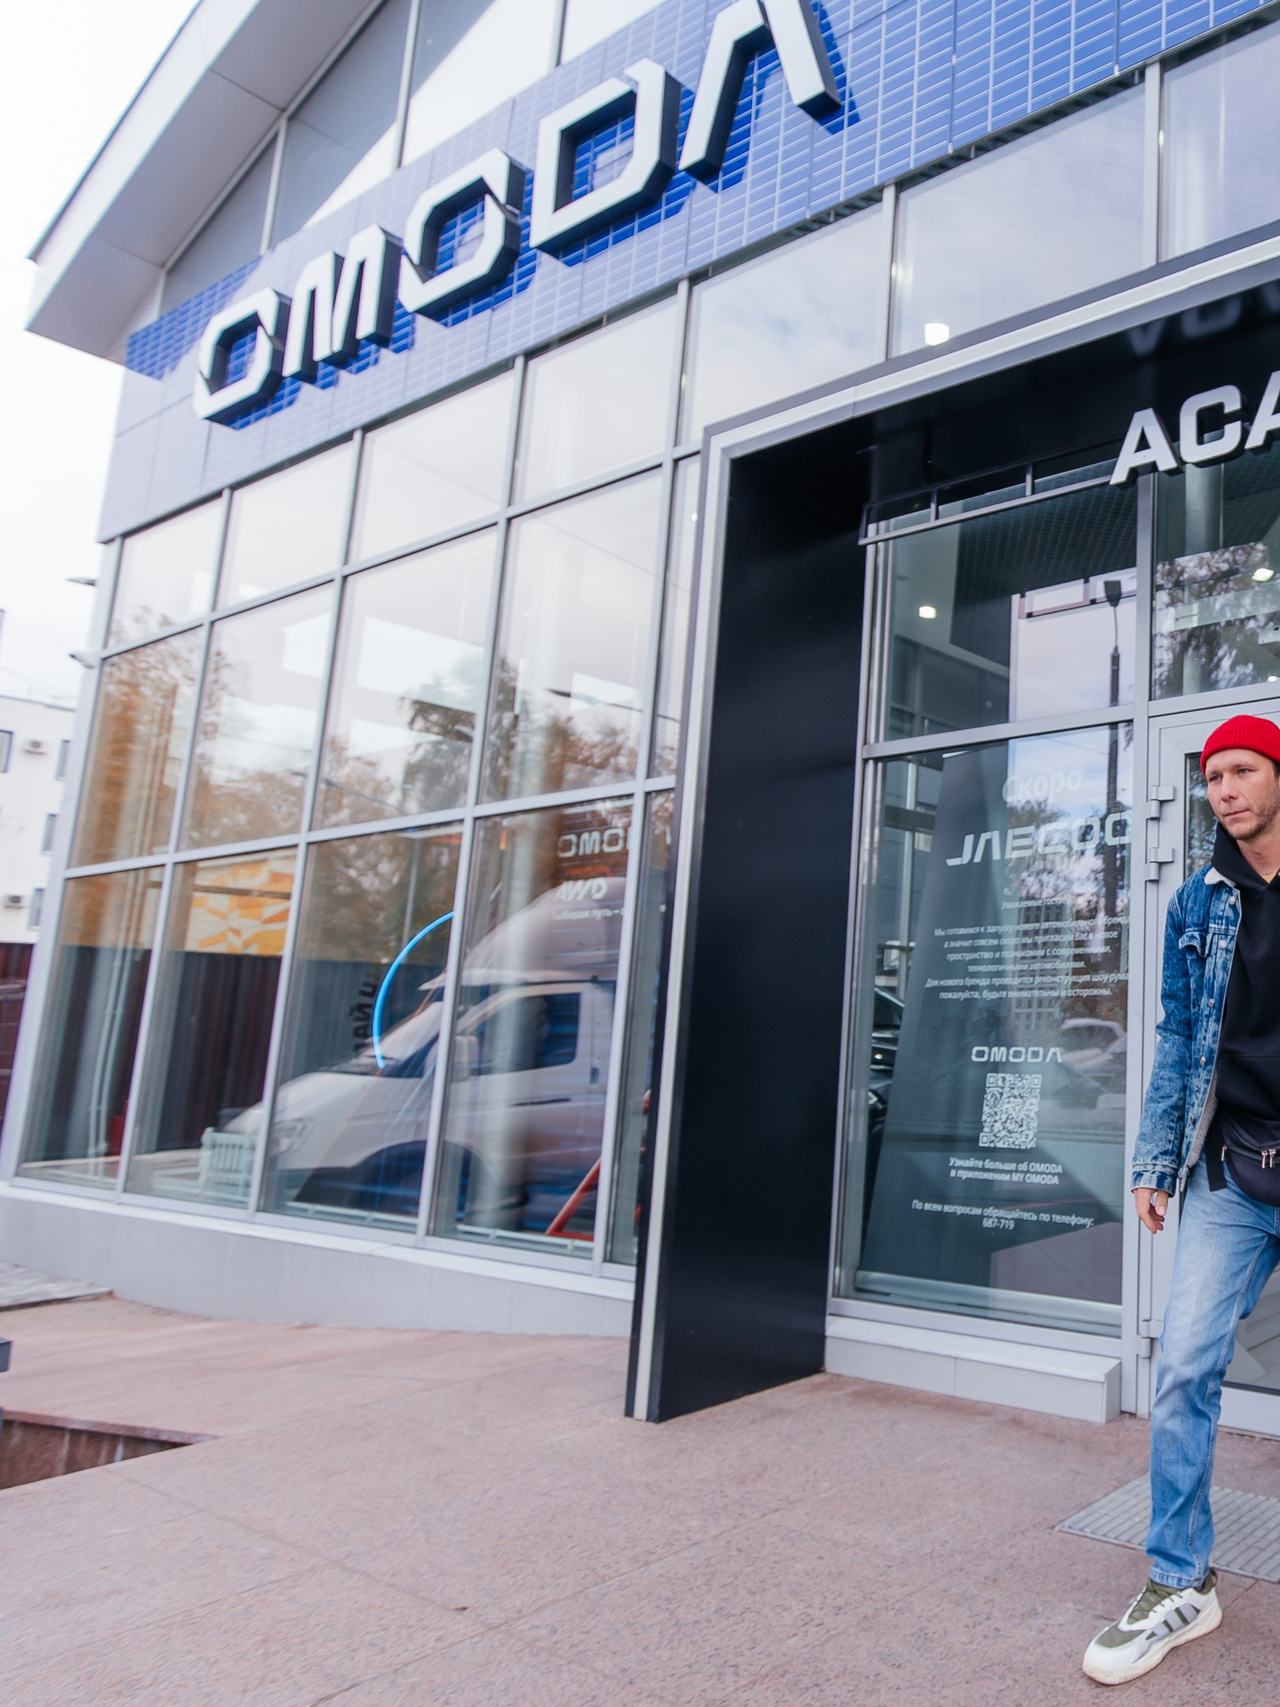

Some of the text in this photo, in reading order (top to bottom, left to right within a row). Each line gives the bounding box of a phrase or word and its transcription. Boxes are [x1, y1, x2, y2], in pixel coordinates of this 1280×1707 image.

[193, 0, 841, 424] OMODA
[1002, 769, 1082, 803] Скоро
[557, 827, 632, 858] OMO
[934, 927, 946, 937] Мы
[986, 924, 1014, 935] запуску
[949, 939, 973, 948] значит
[973, 938, 999, 947] совсем
[999, 937, 1020, 946] скоро
[1074, 932, 1088, 941] Вас
[946, 951, 994, 963] пространство
[925, 978, 939, 988] Для
[939, 978, 964, 986] нового
[964, 976, 991, 987] бренда
[982, 988, 1007, 1001] будьте
[971, 1046, 1063, 1063] OMODA
[949, 1157, 1063, 1174] Узнайте больше об OMODA
[950, 1169, 1060, 1185] в приложении MY OMODA
[912, 1199, 1095, 1229] По всем вопросам обращайтесь по телефону:
[982, 1218, 1015, 1230] 687-719
